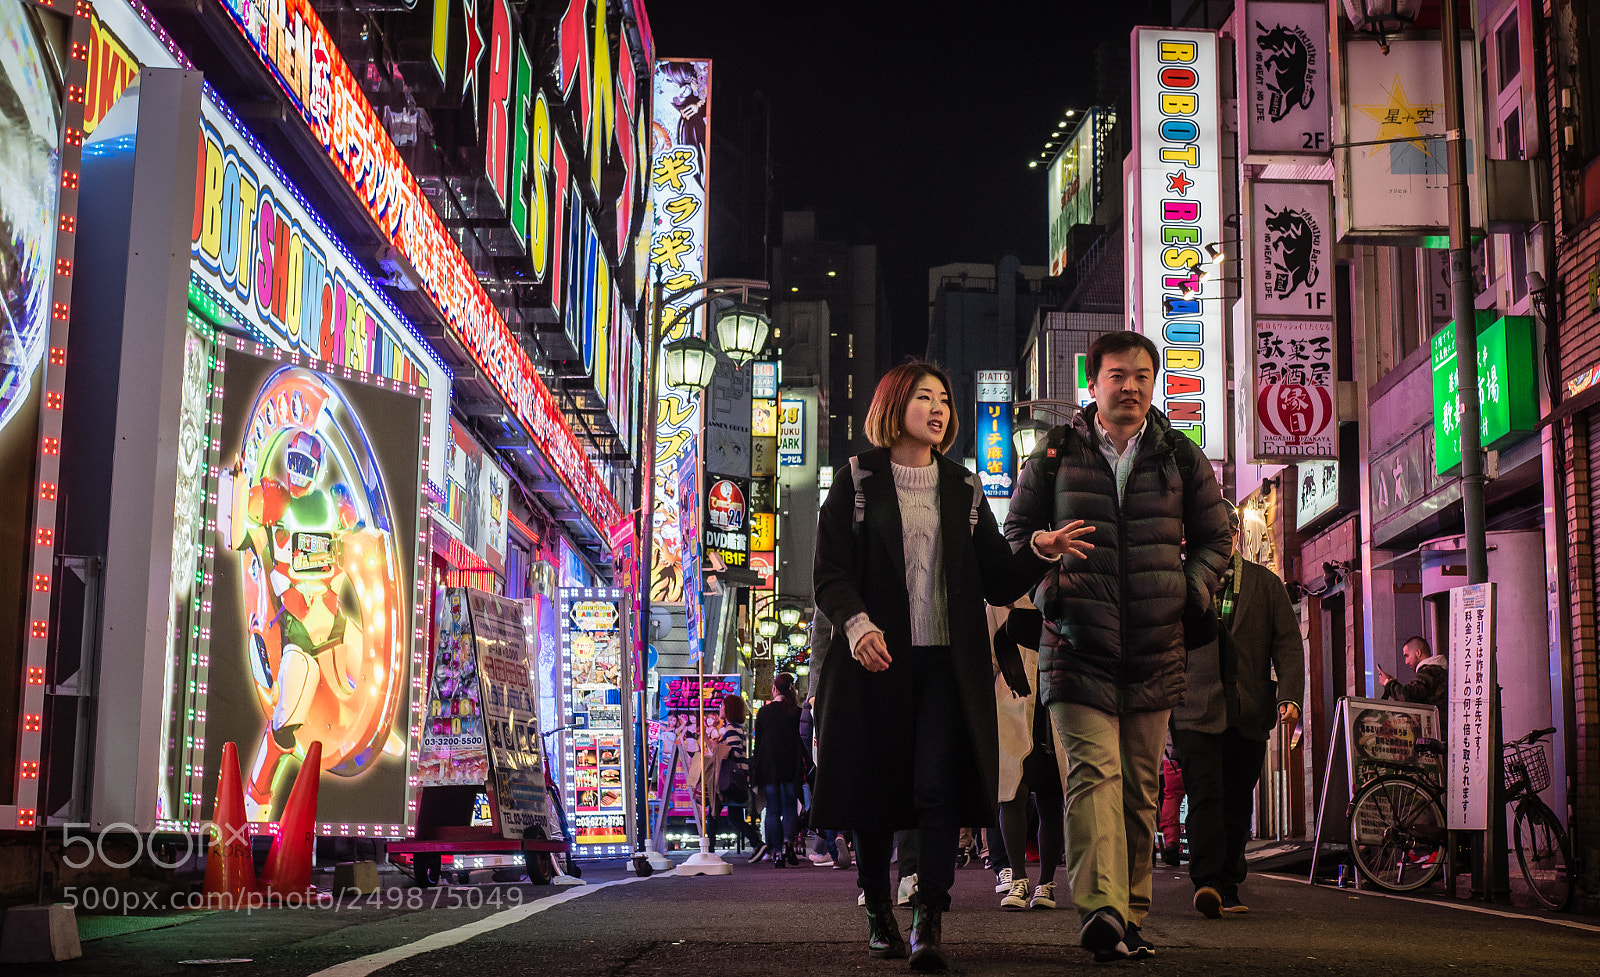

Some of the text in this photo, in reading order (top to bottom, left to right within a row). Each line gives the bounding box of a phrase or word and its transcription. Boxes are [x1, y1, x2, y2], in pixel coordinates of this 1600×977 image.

[1294, 25, 1316, 85] YAKINIKU Bar
[1157, 40, 1200, 168] ROBOT
[1302, 132, 1324, 149] 2F
[1264, 233, 1271, 242] NO
[1300, 208, 1321, 264] YAKINIKU Bar
[258, 199, 325, 355] SHOW
[1265, 270, 1272, 280] NO
[1277, 274, 1287, 291] 2nd
[1305, 292, 1326, 309] 1F
[1160, 198, 1205, 450] RESTAURANT
[1257, 331, 1331, 361] 駄菓子
[979, 372, 1010, 381] PIATTO
[1258, 362, 1331, 387] 居酒屋
[1280, 387, 1309, 433] 縁日
[987, 405, 1003, 474] リーチ麻雀
[1263, 441, 1333, 456] Ennichi
[298, 533, 329, 553] ROBOT
[706, 530, 747, 552] DVD鑑賞
[432, 699, 477, 717] ROBOT
[433, 717, 476, 735] SHOW
[424, 736, 482, 746] 03-3200-5500
[581, 816, 625, 827] 03-6273-9736
